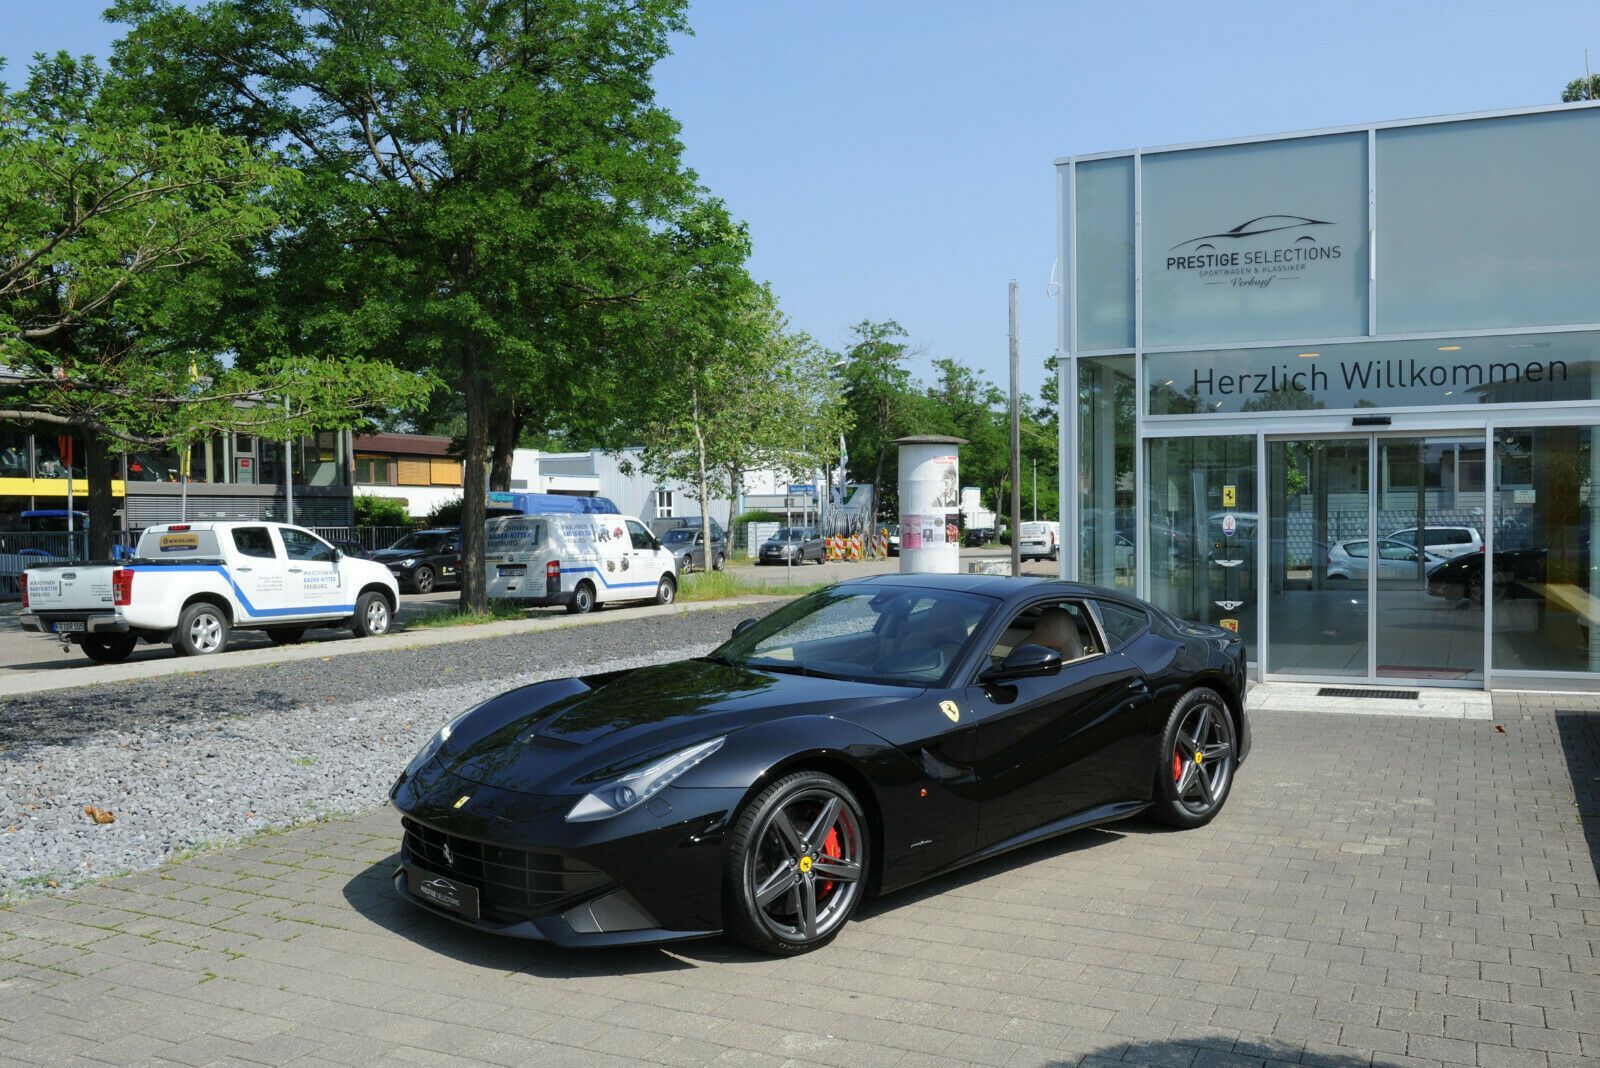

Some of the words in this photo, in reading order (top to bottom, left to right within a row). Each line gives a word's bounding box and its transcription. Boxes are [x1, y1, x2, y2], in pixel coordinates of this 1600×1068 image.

[1167, 252, 1239, 270] PRESTIGE
[1244, 246, 1341, 265] SELECTIONS
[1200, 267, 1250, 277] SPORTWAGEN
[1263, 264, 1306, 273] KLASSIKER
[1231, 275, 1276, 288] Verkauf
[1193, 364, 1328, 396] Herzlich
[1340, 359, 1568, 390] Willkommen
